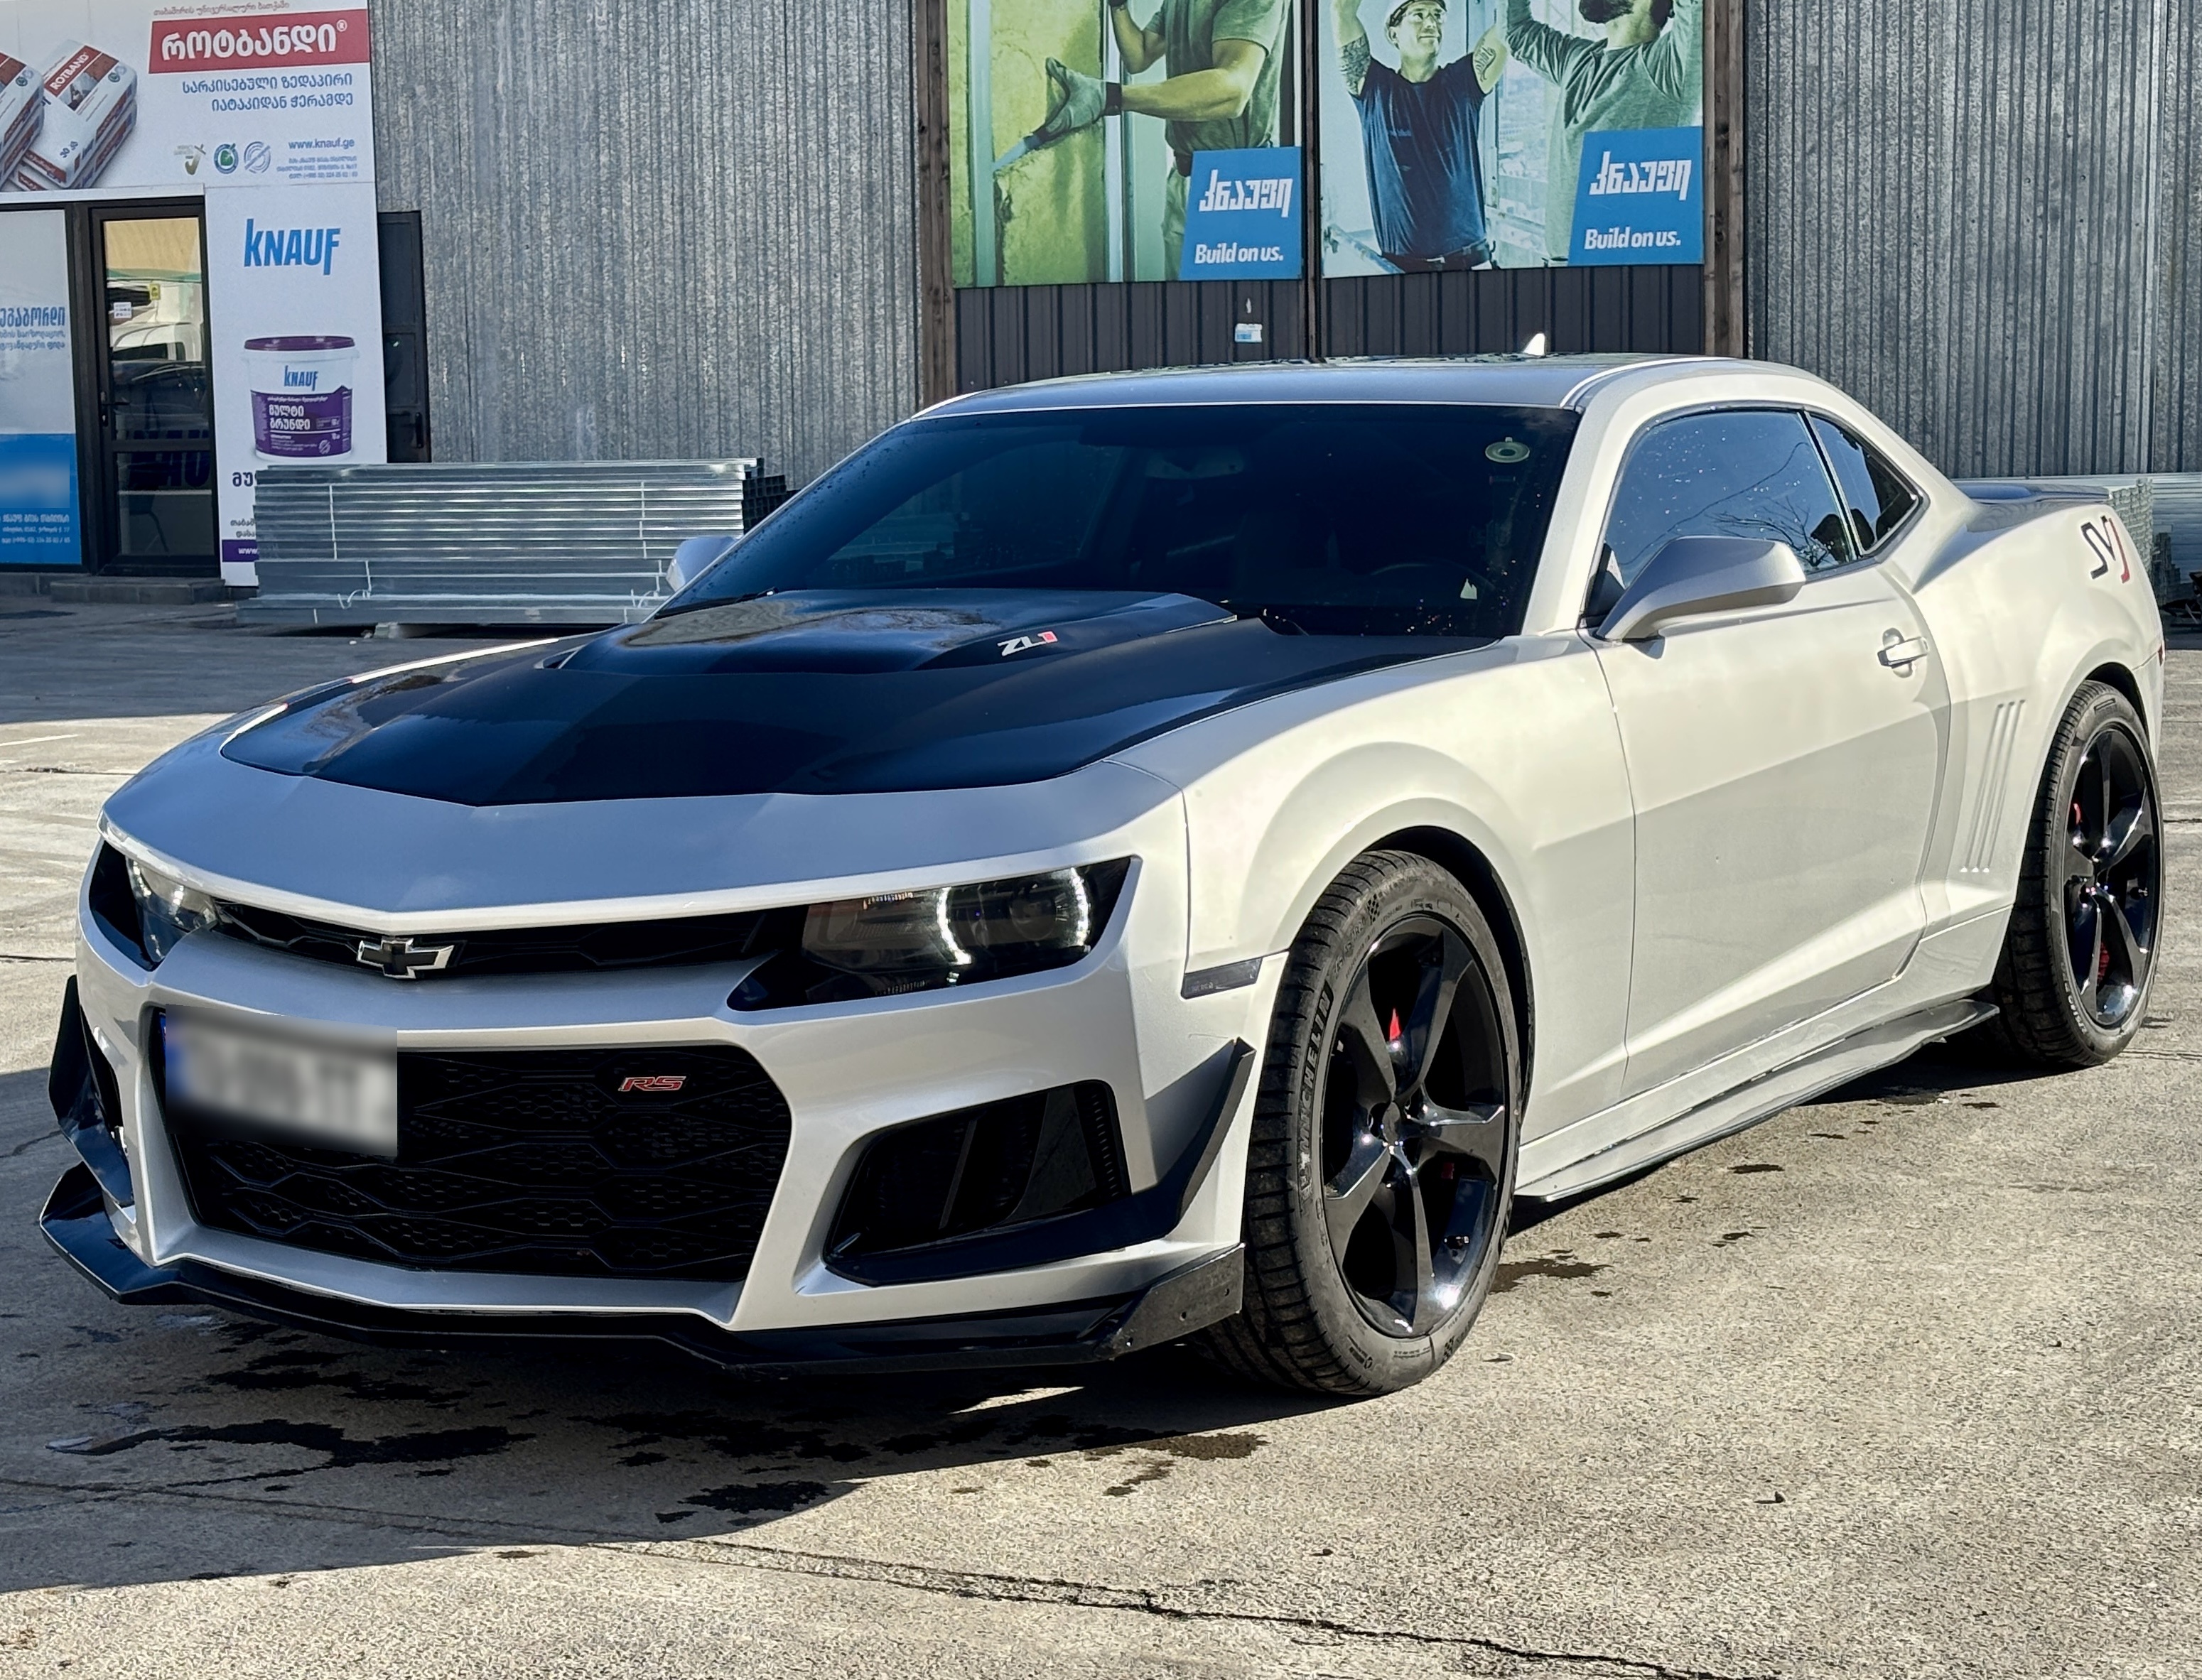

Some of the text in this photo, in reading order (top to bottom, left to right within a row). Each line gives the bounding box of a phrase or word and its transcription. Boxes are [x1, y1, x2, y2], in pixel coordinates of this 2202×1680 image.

[183, 73, 352, 94] სარკისებული ზედაპირი
[212, 93, 353, 112] იატაკიდან ჭერამდე
[288, 137, 355, 150] www.knauf.ge
[1584, 227, 1681, 250] Build on us.
[1194, 242, 1284, 264] Build on us.
[997, 631, 1058, 656] ZL1
[1300, 990, 1331, 1153] MICHELIN
[617, 1075, 687, 1092] RS
